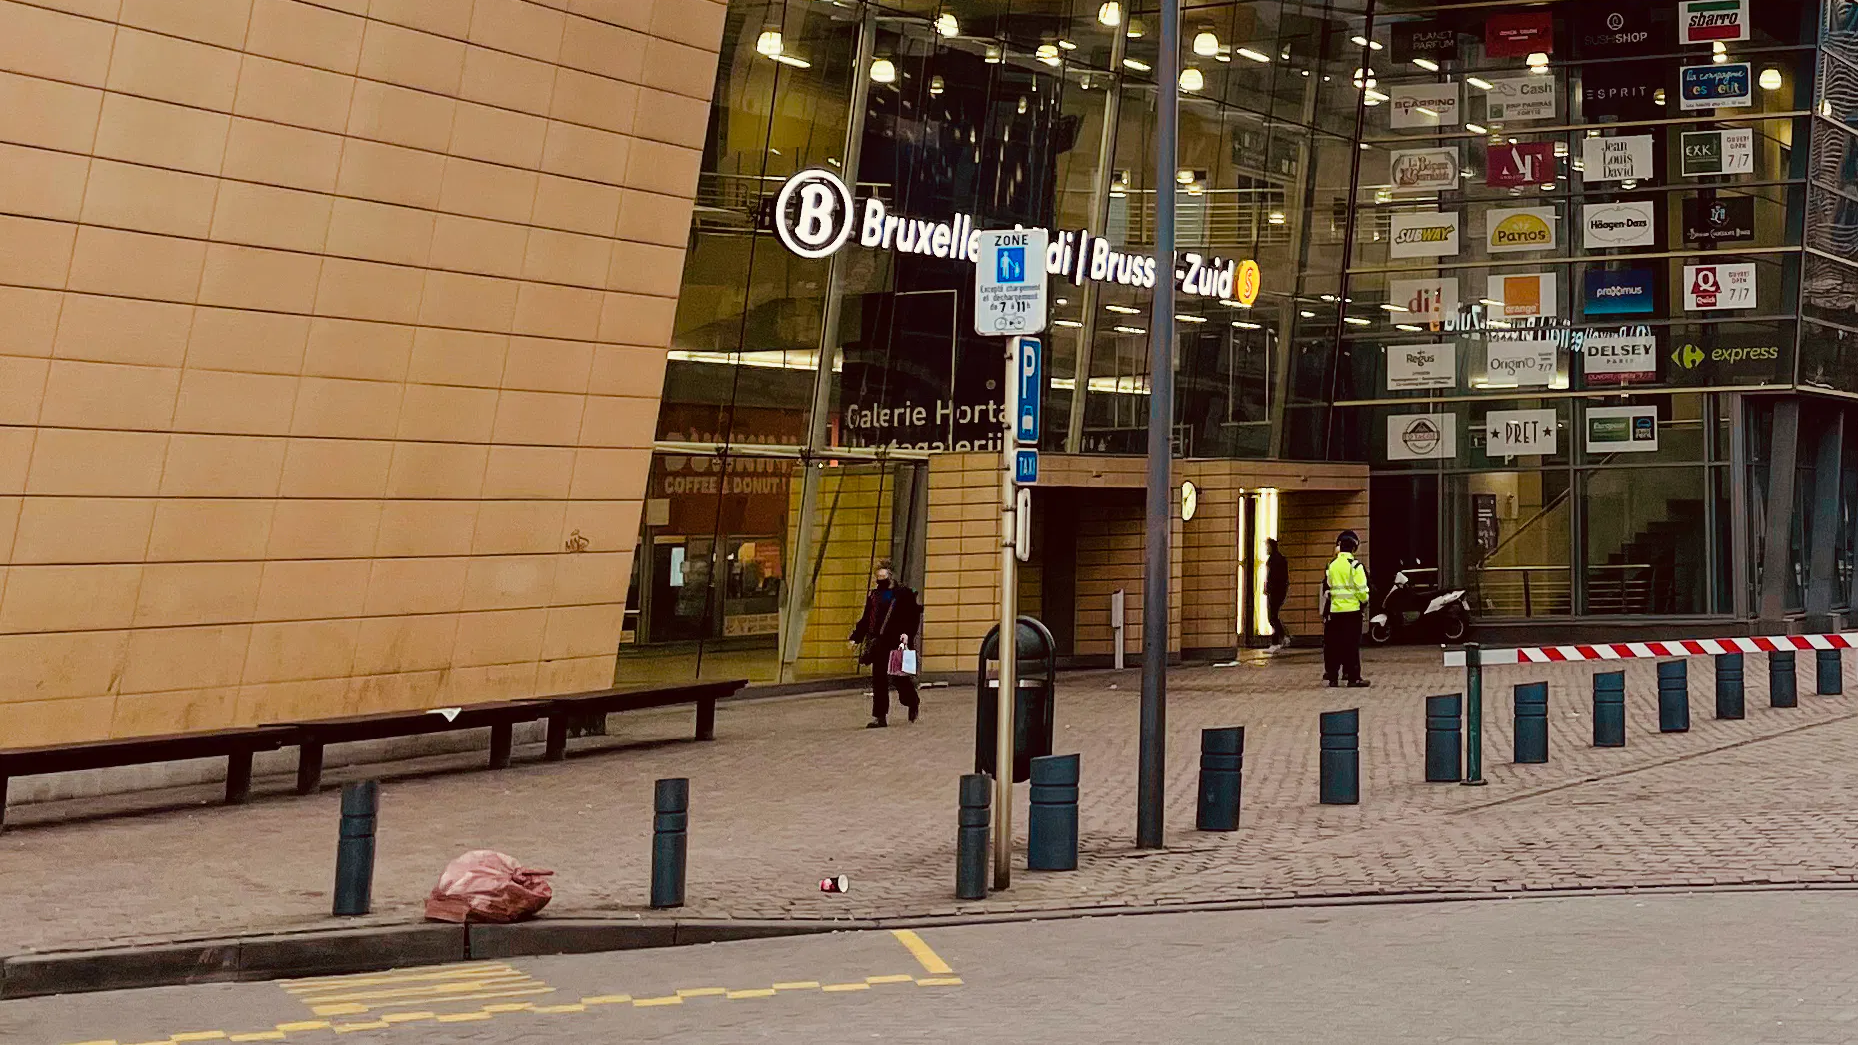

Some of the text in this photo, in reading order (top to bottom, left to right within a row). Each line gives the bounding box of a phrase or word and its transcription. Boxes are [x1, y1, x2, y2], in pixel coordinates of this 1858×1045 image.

[1689, 11, 1739, 27] sbarro
[1412, 30, 1453, 42] PLANET
[1413, 40, 1454, 51] PARFUM
[1520, 82, 1553, 96] Cash
[1586, 86, 1647, 100] ESPRIT
[1601, 139, 1628, 153] Jean
[1602, 152, 1633, 165] Louis
[1603, 164, 1634, 179] David
[994, 234, 1029, 247] ZONE
[1395, 224, 1455, 244] SUBWAY
[1497, 230, 1546, 243] Panos
[1697, 270, 1716, 291] Q
[1408, 286, 1442, 314] di!
[1696, 295, 1716, 304] Quick
[1729, 287, 1750, 301] 7/7
[1000, 301, 1006, 313] 7
[1505, 305, 1537, 315] orange
[1587, 344, 1653, 357] DELSEY
[1711, 346, 1779, 364] express
[1406, 353, 1435, 367] Regus
[1022, 345, 1036, 399] P
[848, 401, 927, 429] Galerie
[1505, 420, 1539, 444] PRET
[1019, 456, 1036, 477] TAXI
[664, 476, 717, 495] COFFEE
